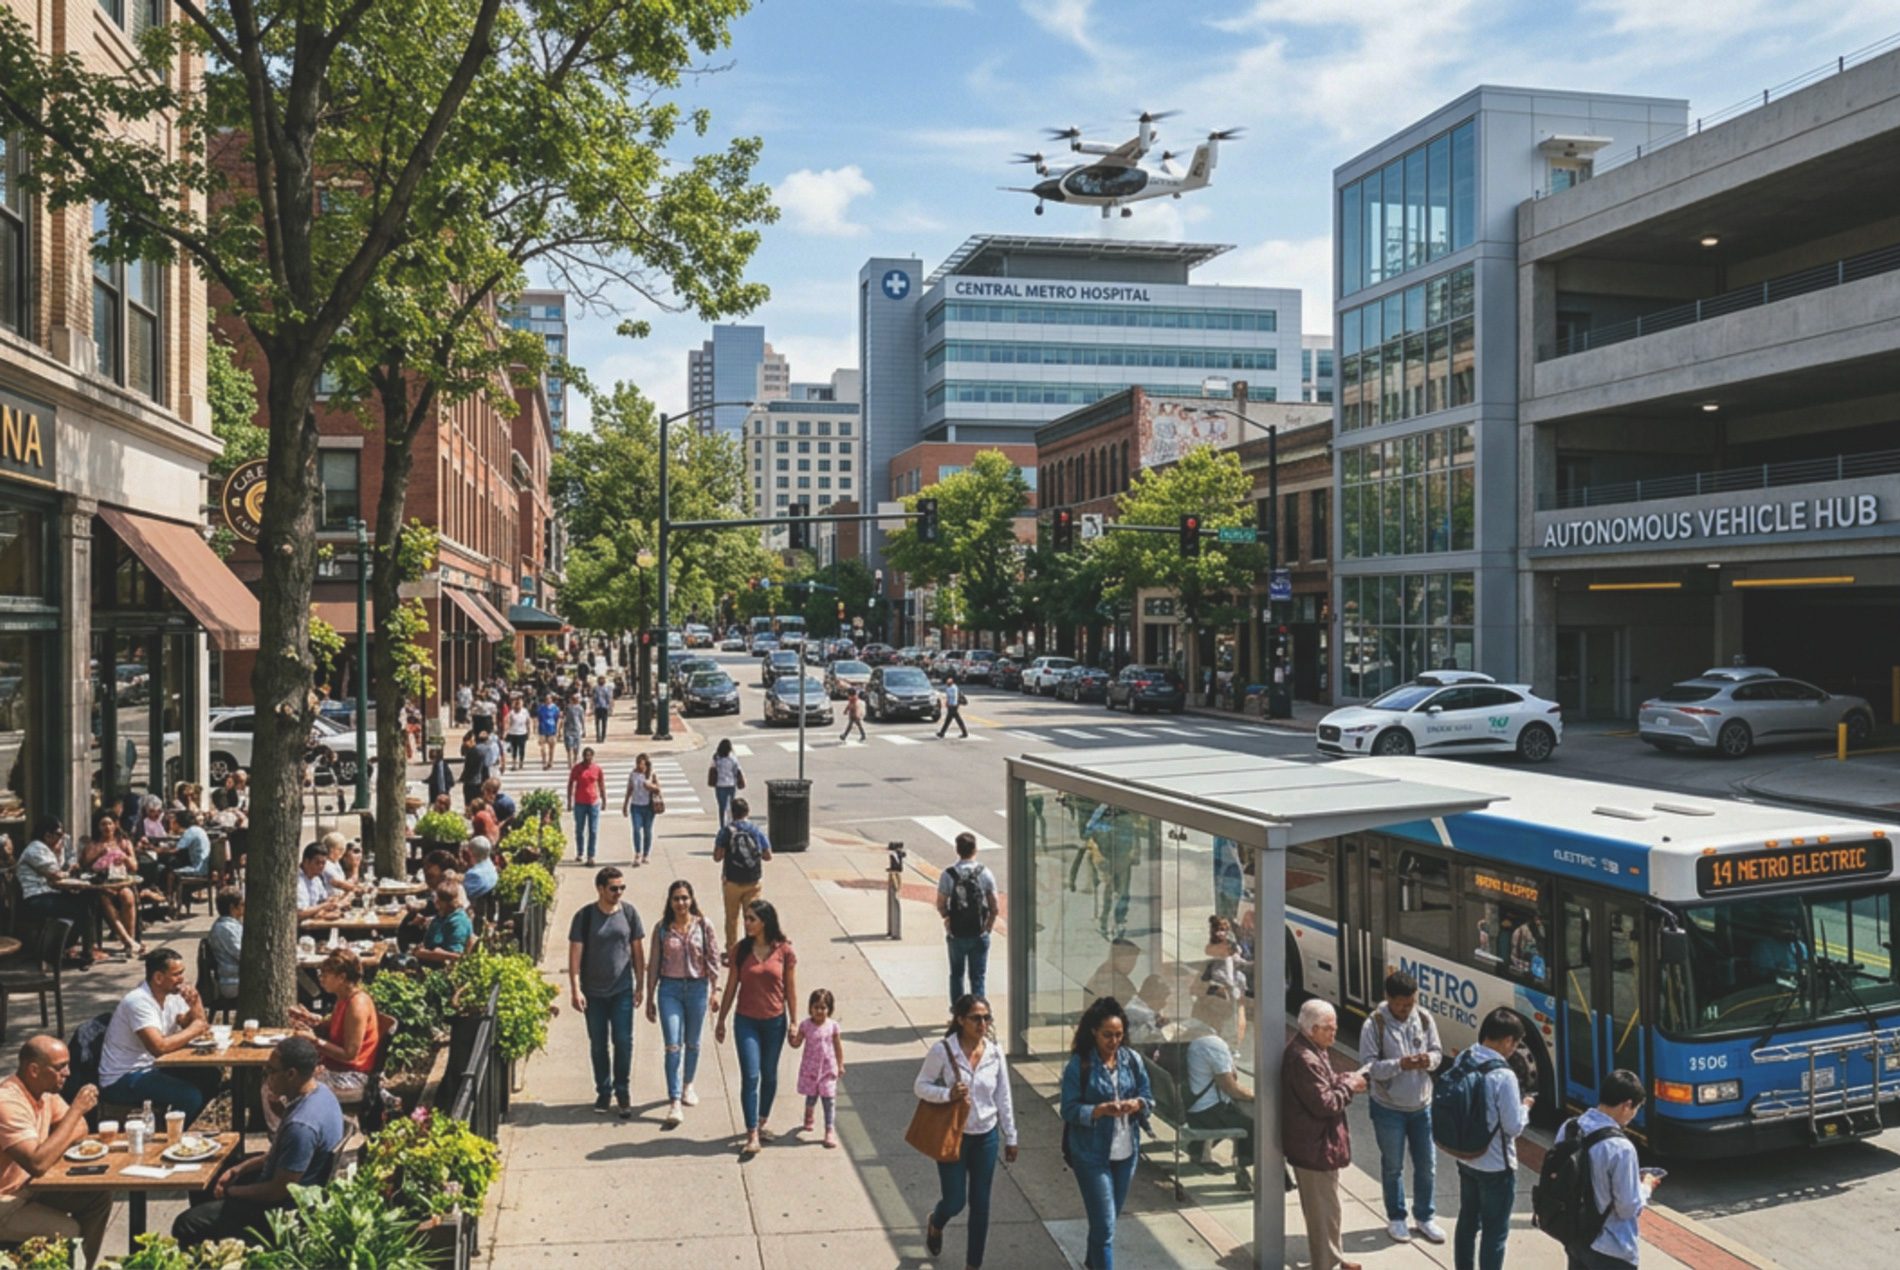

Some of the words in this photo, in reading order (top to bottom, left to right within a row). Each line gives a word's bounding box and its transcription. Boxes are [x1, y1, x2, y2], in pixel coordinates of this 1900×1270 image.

[955, 281, 1022, 297] CENTRAL
[1025, 284, 1077, 299] METRO
[1081, 286, 1151, 301] HOSPITAL
[2, 403, 43, 467] NA
[1544, 511, 1693, 547] AUTONOMOUS
[1698, 500, 1806, 537] VEHICLE
[1814, 494, 1878, 527] HUB
[1712, 860, 1732, 886] 14
[1737, 855, 1789, 881] METRO
[1793, 848, 1867, 875] ELECTRIC
